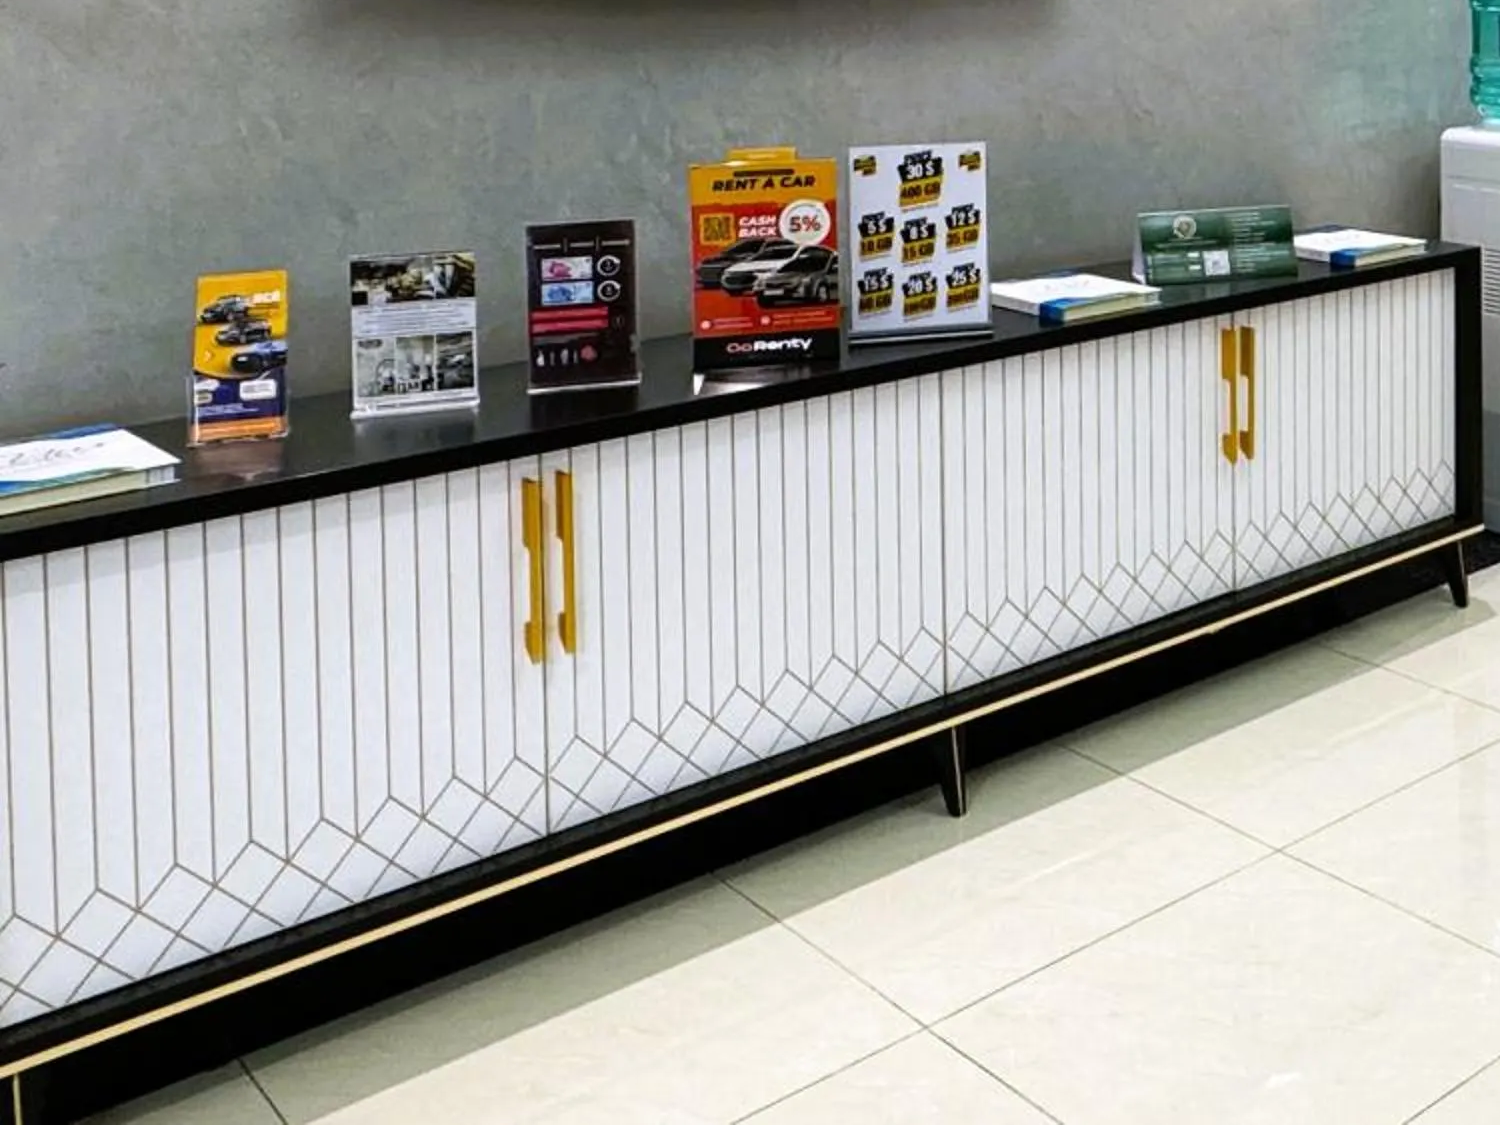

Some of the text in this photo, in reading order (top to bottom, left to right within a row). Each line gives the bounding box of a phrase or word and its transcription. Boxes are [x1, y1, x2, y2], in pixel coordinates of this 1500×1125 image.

[906, 164, 923, 179] 30
[712, 175, 816, 192] RENT A CAR
[738, 215, 776, 226] CASH
[789, 214, 821, 232] 5%
[738, 227, 776, 238] BACK
